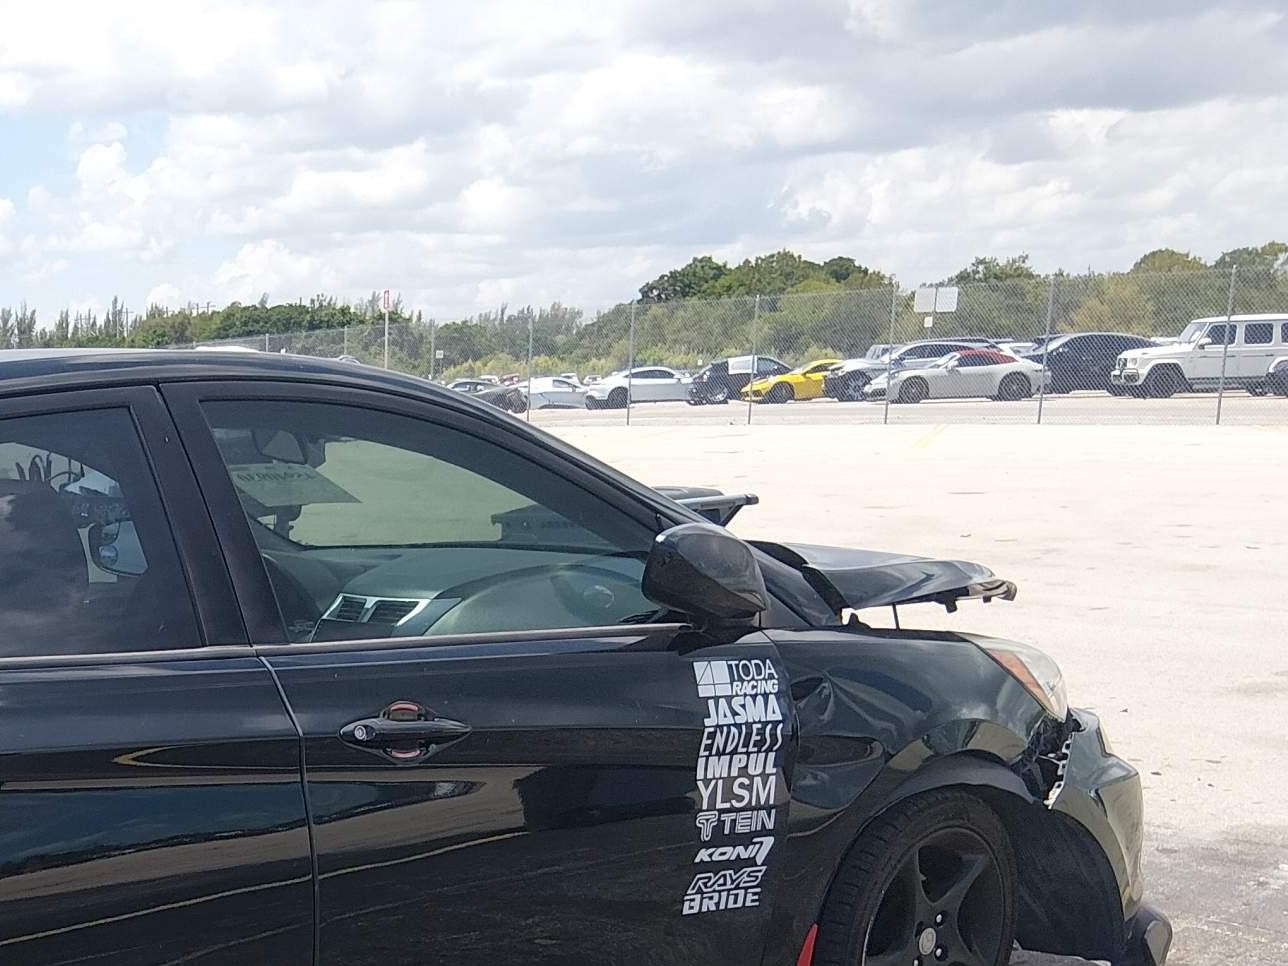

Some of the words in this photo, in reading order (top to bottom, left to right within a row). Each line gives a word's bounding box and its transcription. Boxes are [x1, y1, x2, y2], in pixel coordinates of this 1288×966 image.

[728, 659, 778, 681] TODA
[732, 679, 779, 696] RACING
[704, 694, 783, 727] JASMA
[698, 723, 783, 756] ENDLESS
[696, 752, 777, 780] IMPUL
[696, 775, 776, 810] YLSM
[720, 809, 776, 834] TEIN
[686, 865, 768, 895] RAYS
[681, 887, 762, 916] BRIDE
